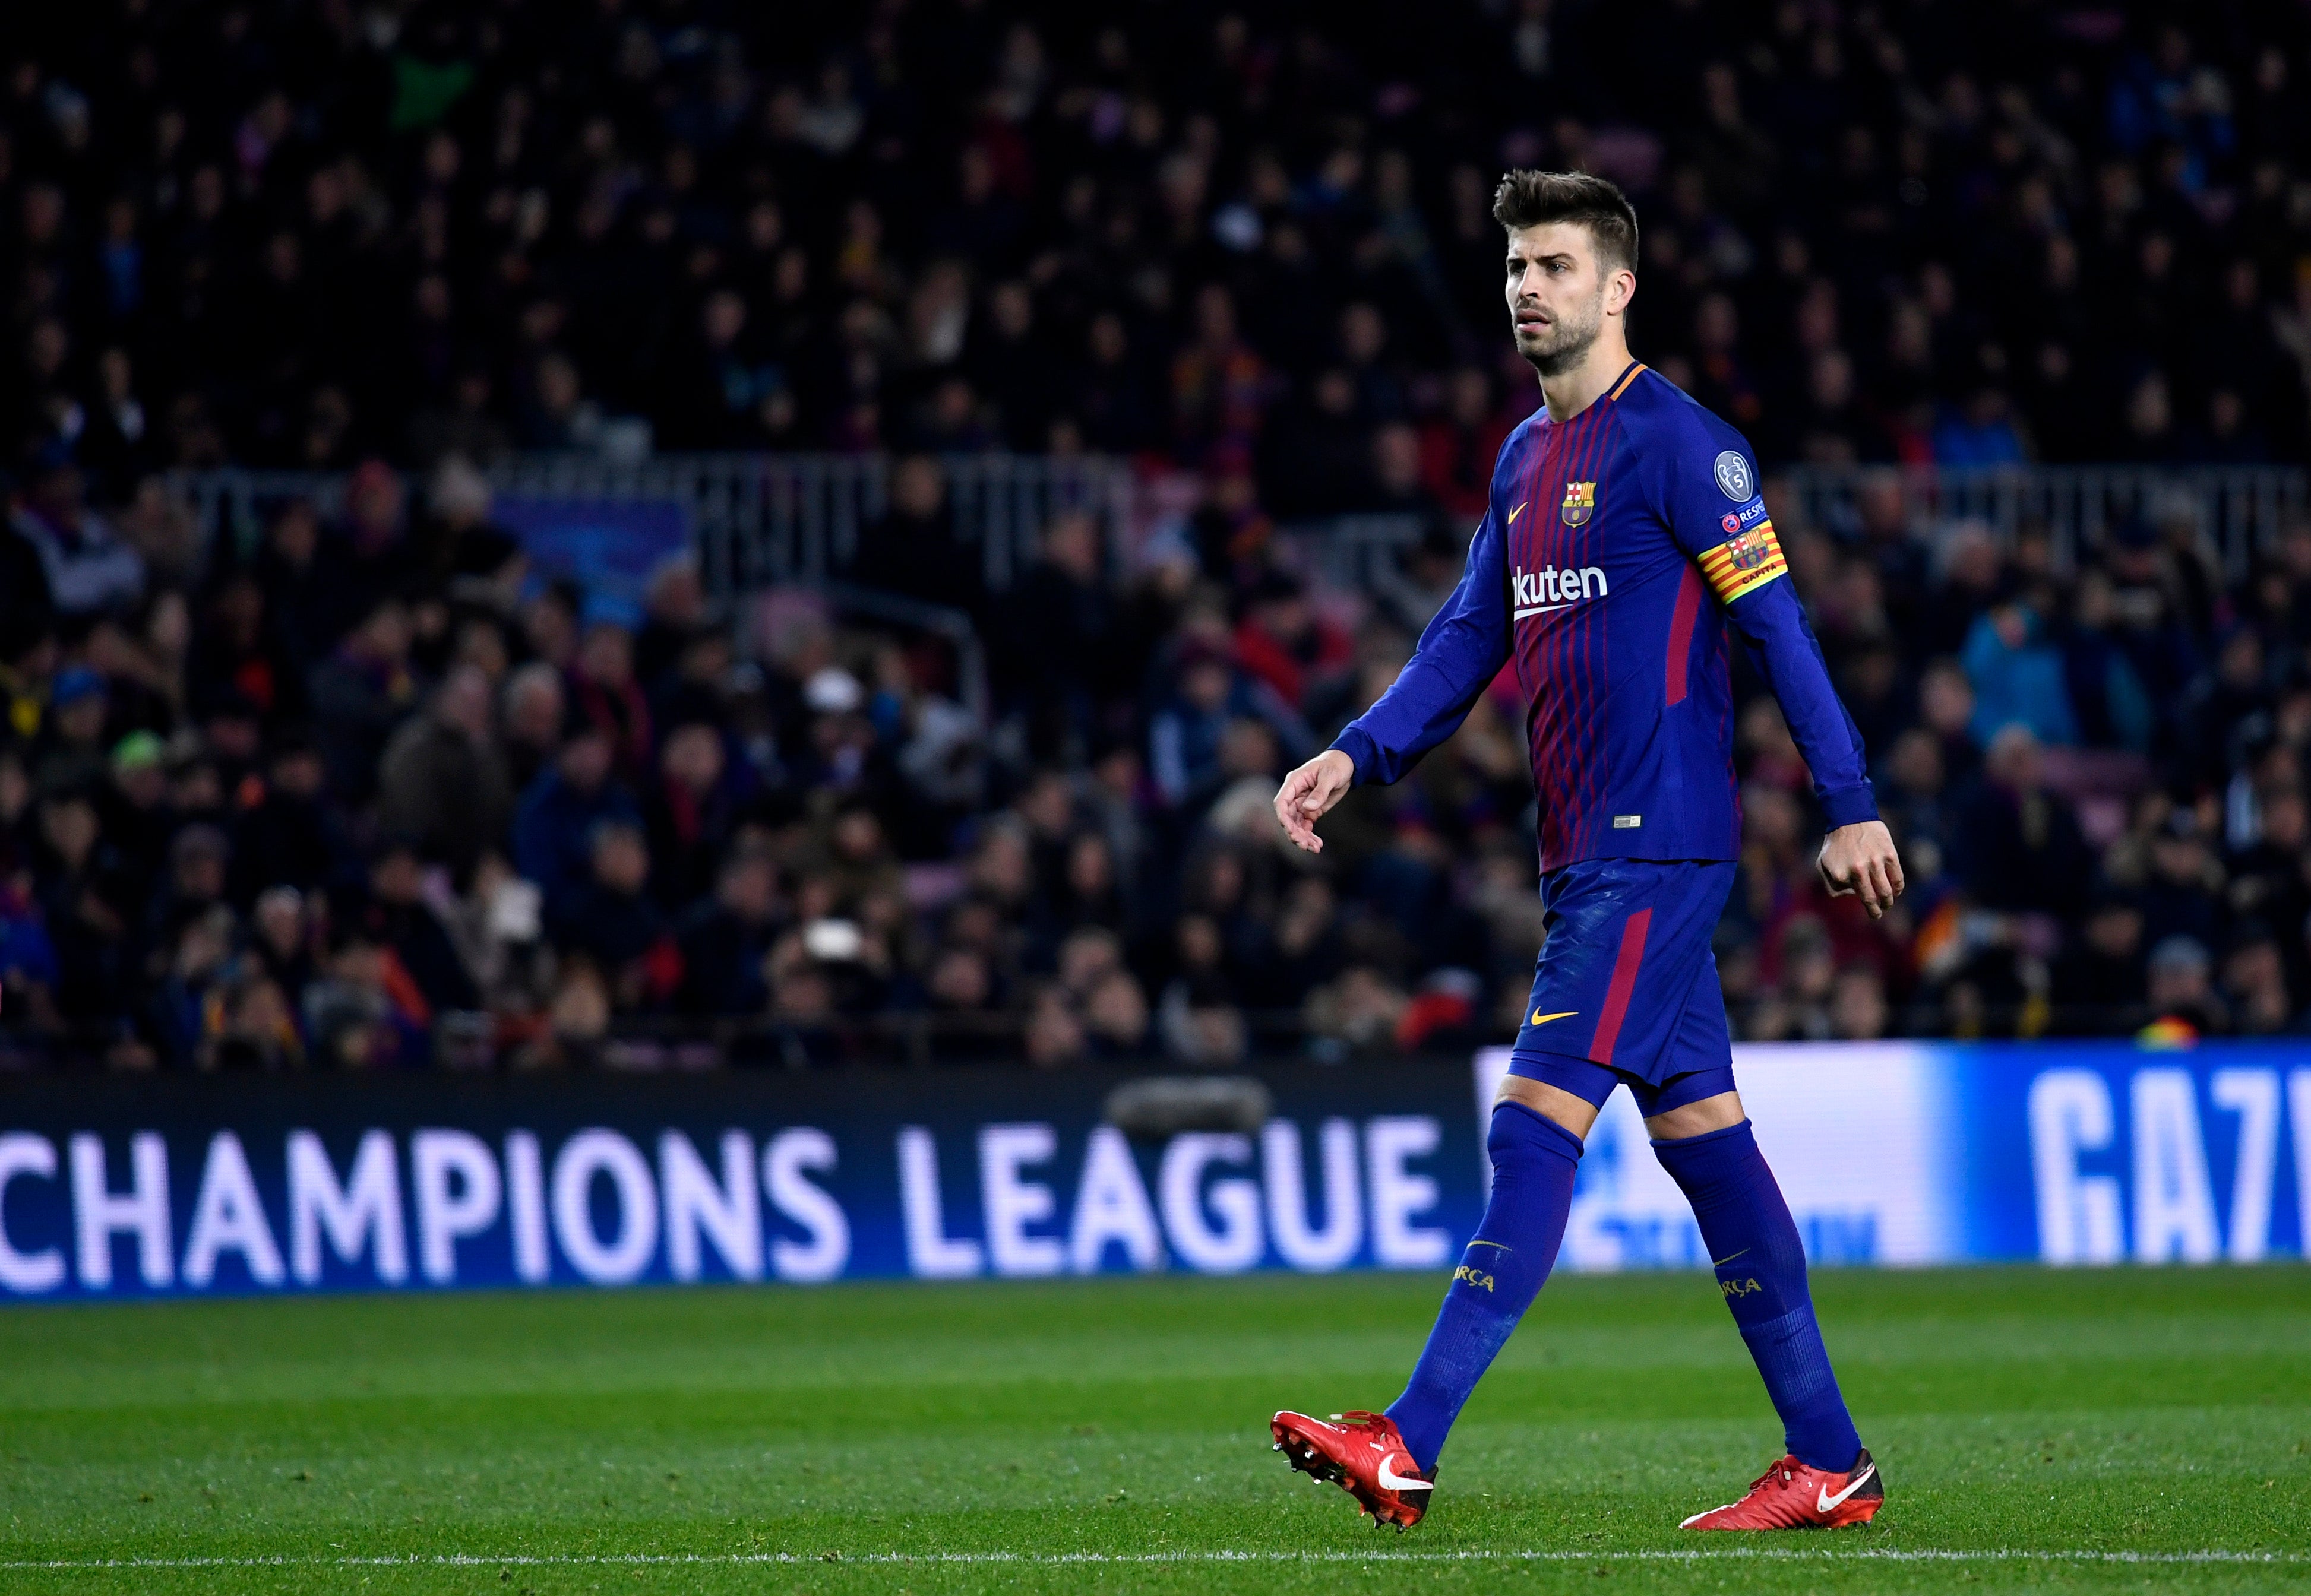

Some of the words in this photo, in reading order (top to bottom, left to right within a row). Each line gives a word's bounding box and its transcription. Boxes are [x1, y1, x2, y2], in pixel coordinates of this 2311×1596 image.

[1733, 474, 1744, 489] 5
[1738, 499, 1766, 523] RESPE
[2027, 1066, 2311, 1266] GAZ
[0, 1128, 852, 1293] CHAMPIONS
[897, 1116, 1452, 1278] LEAGUE
[1721, 1277, 1762, 1299] RÇA
